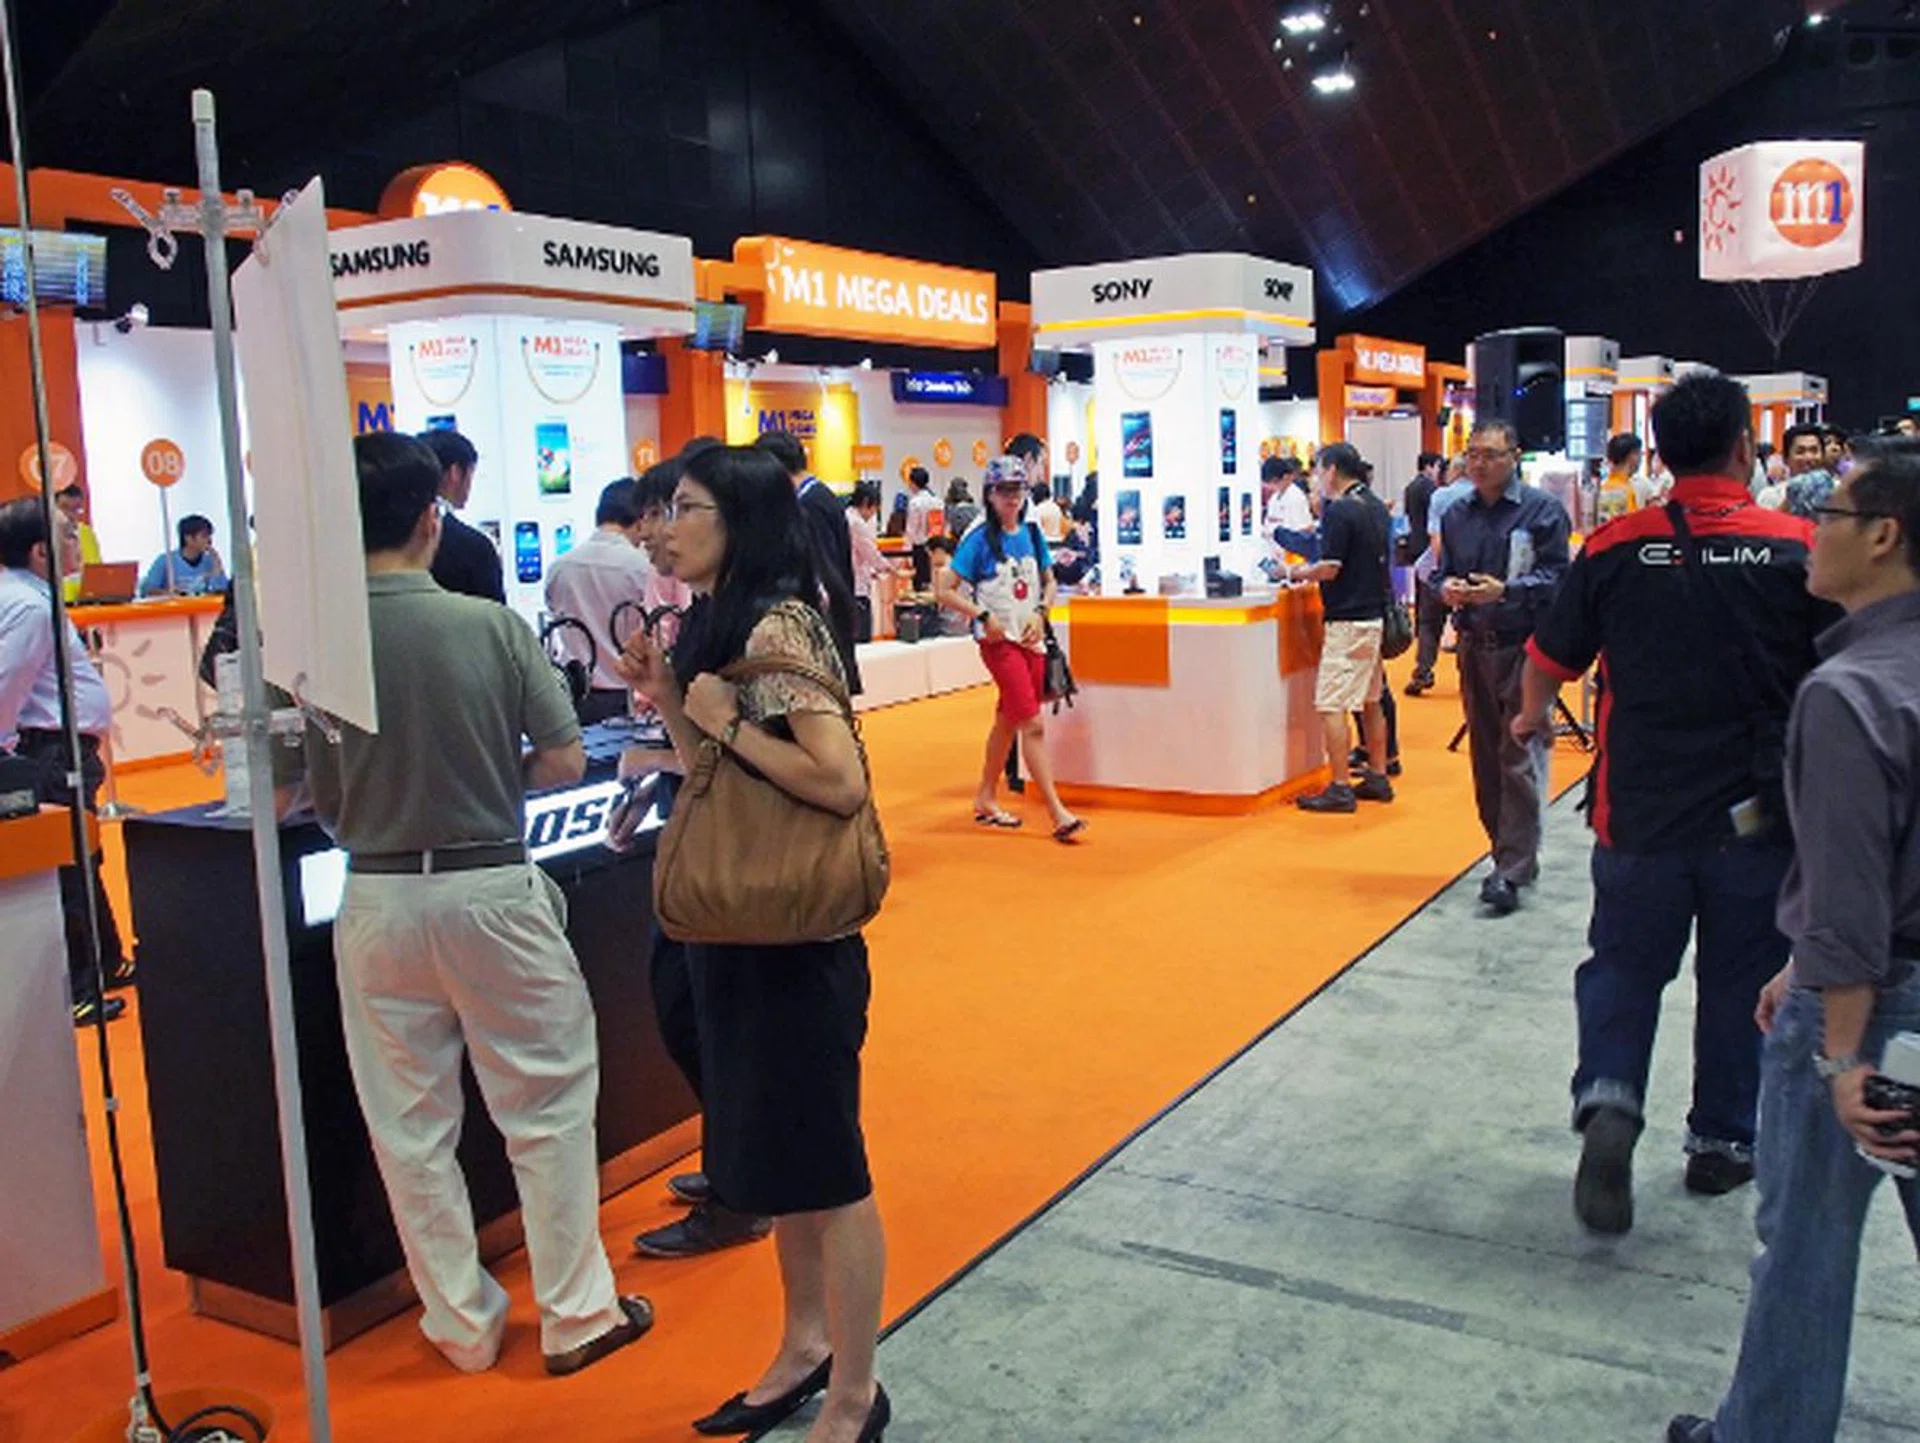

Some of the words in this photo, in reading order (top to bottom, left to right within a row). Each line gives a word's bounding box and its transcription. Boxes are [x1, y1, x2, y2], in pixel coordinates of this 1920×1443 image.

[330, 240, 431, 277] SAMSUNG
[543, 241, 660, 277] SAMSUNG
[782, 266, 828, 308] M1
[836, 271, 915, 318] MEGA
[917, 284, 988, 325] DEALS
[1091, 279, 1153, 302] SONY
[358, 401, 394, 433] M
[149, 450, 180, 476] 08
